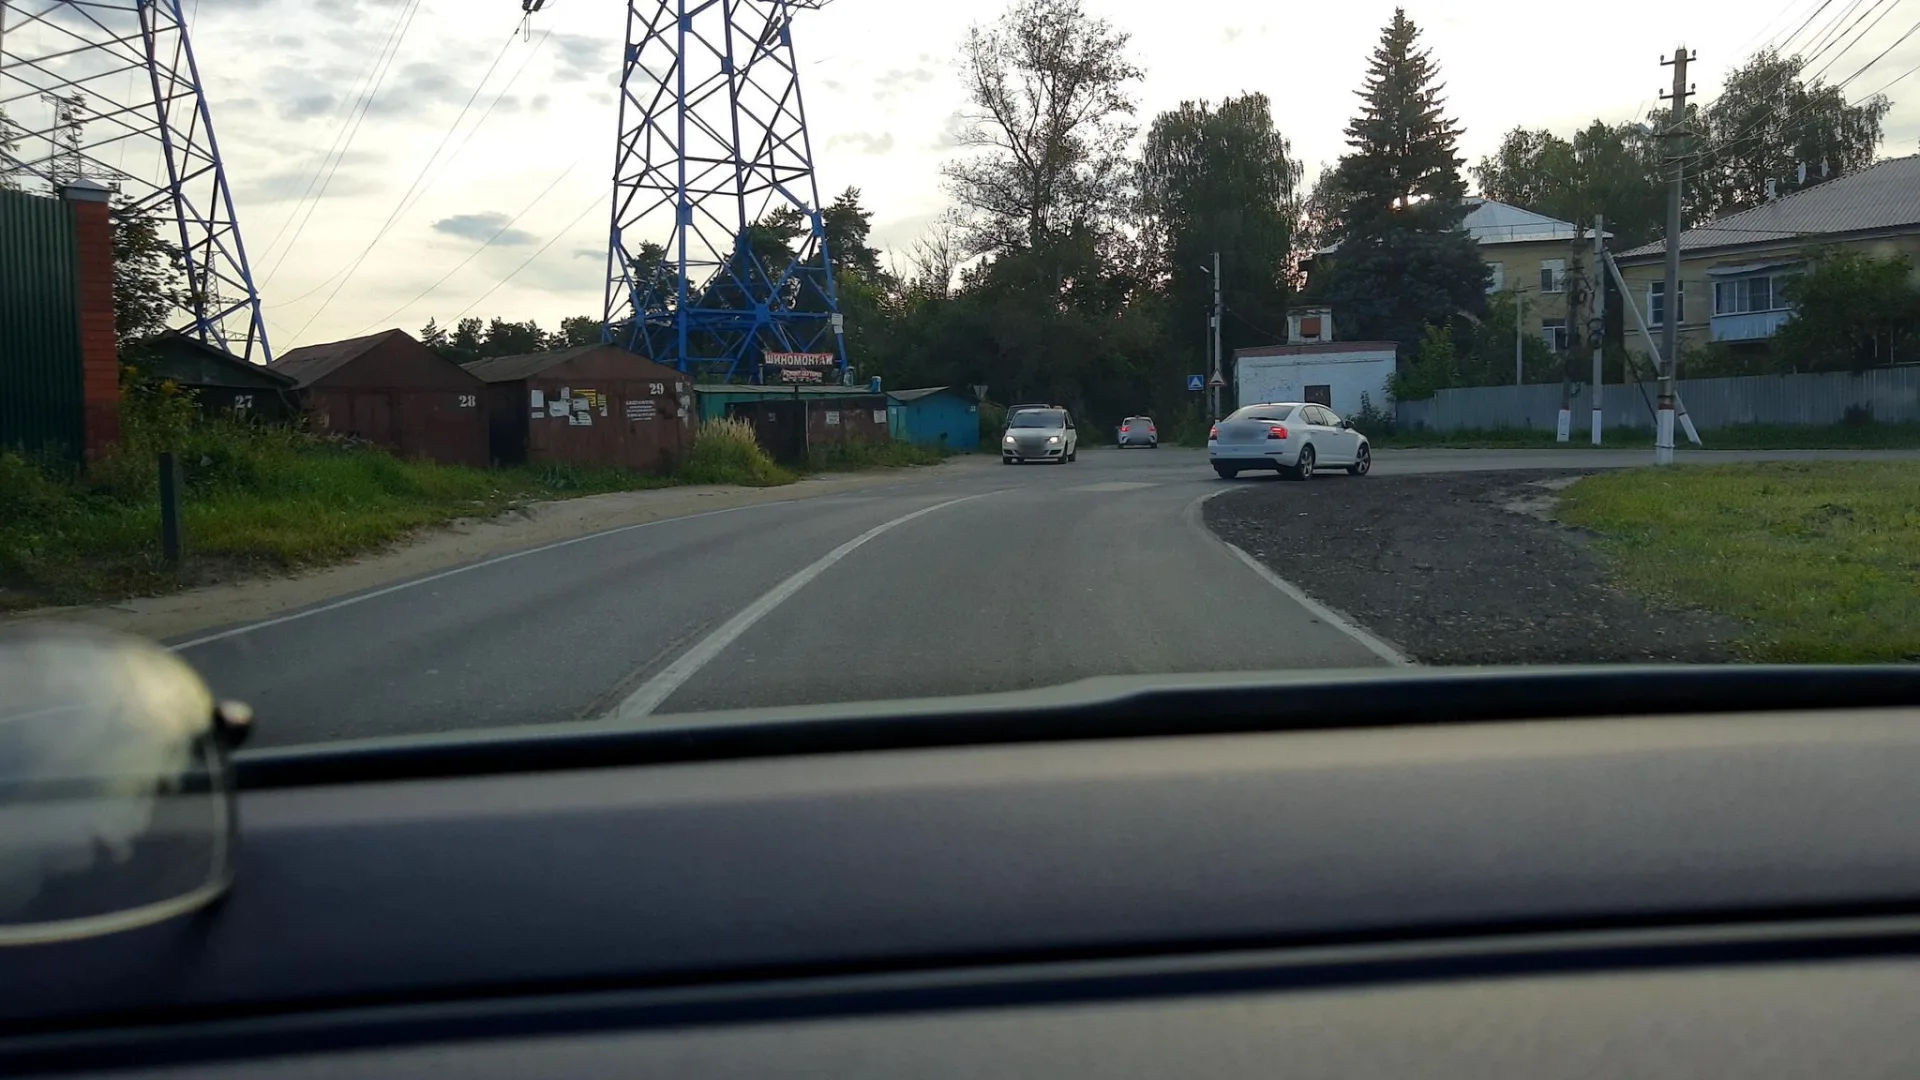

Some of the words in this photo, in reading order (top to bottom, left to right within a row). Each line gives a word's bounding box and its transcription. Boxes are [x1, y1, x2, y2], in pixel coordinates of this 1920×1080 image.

[765, 352, 833, 365] ШИНОМОНТАЖ
[649, 383, 664, 395] 29
[235, 395, 253, 408] 27
[459, 395, 476, 407] 28
